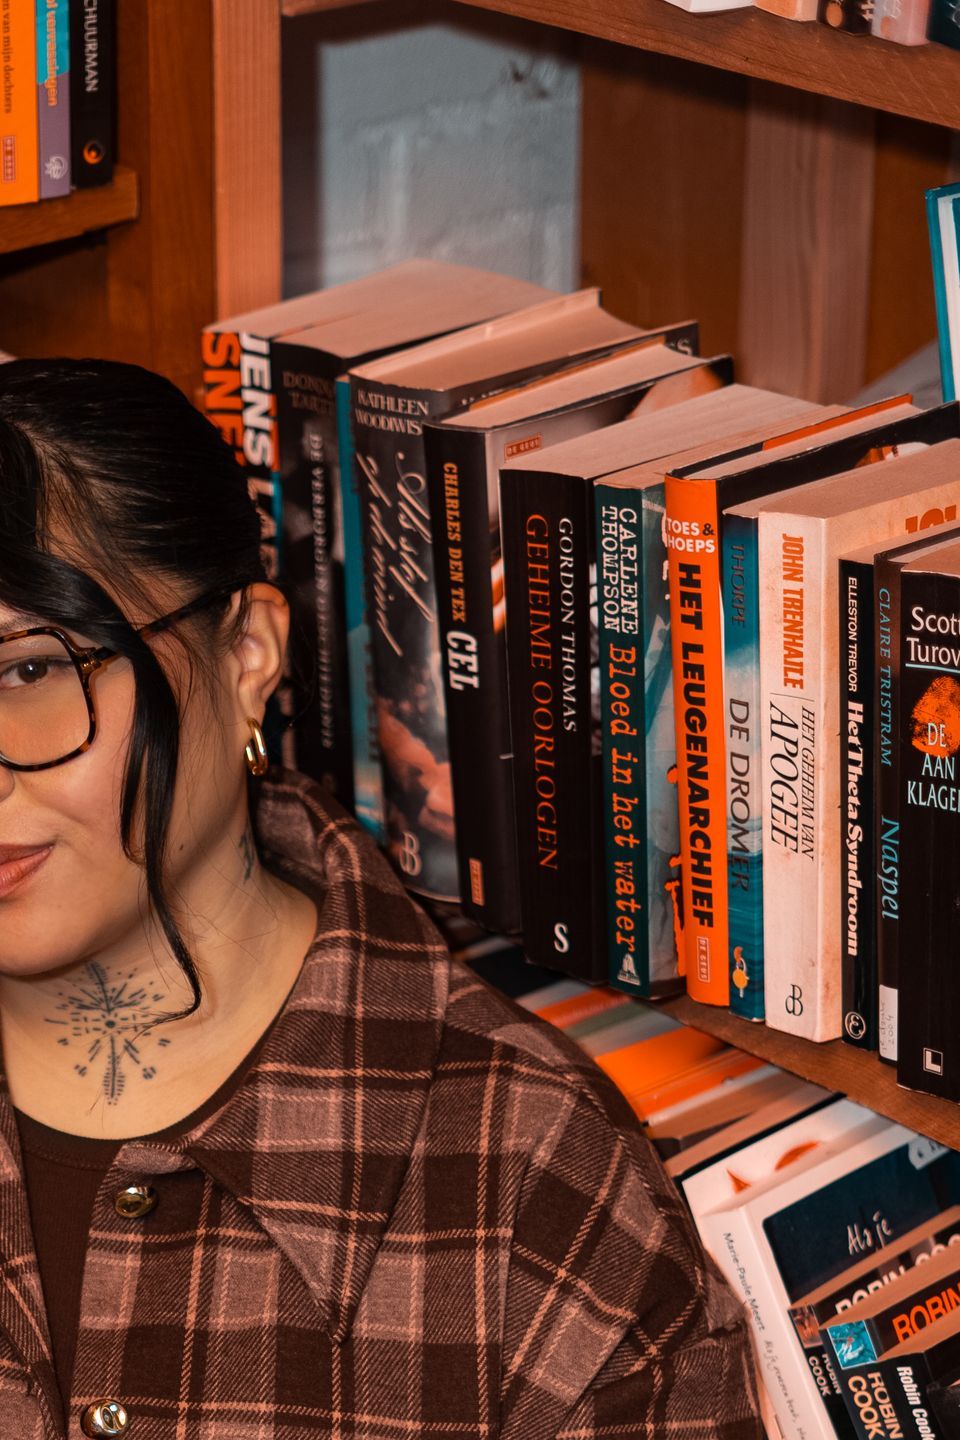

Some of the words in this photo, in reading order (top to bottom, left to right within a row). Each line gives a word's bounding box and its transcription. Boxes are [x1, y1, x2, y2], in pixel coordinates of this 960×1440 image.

[240, 332, 273, 468] JENS
[355, 409, 424, 436] WOODIWIS
[357, 389, 429, 417] KATHLEEN
[443, 462, 461, 541] CHARLES
[667, 518, 700, 537] TOES
[702, 522, 716, 536] &
[448, 547, 464, 585] DEN
[558, 517, 576, 624] GORDON
[601, 505, 620, 633] THOMPSON
[618, 507, 639, 635] CARLENE
[667, 536, 716, 554] HOEPS
[782, 533, 804, 583] JOHN
[451, 588, 466, 623] TEX
[526, 514, 552, 670] GEHEIME
[678, 562, 703, 631] HET
[848, 576, 858, 640] ELLESTON
[878, 588, 890, 659] CLAIRE
[446, 631, 480, 691] CEL
[783, 588, 804, 690] TRENHAILE
[848, 642, 858, 693] TREVOR
[560, 631, 577, 732] THOMAS
[608, 643, 638, 737] Bloed
[728, 698, 750, 743] DE
[801, 705, 815, 744] HET
[847, 700, 863, 742] Het
[880, 666, 892, 766] TRISTRAM
[927, 723, 947, 748] DE
[532, 680, 559, 870] OORLOGEN
[611, 747, 639, 785] in
[681, 641, 714, 929] LEUGENARCHIEF
[769, 700, 801, 854] APOGEE
[801, 745, 815, 820] GEHEIM
[847, 742, 863, 820] Theta
[907, 781, 960, 813] KLAGE
[921, 753, 955, 779] AAN
[612, 792, 640, 848] het
[728, 751, 751, 892] DROMER
[801, 822, 814, 861] VAN
[847, 823, 863, 957] Syndroom
[876, 815, 900, 920] Naspel
[614, 859, 642, 953] water
[847, 1225, 872, 1255] Als
[873, 1211, 893, 1250] je
[723, 1232, 751, 1299] Marie-Paule
[749, 1298, 767, 1332] Meert
[808, 1355, 831, 1397] COOK
[848, 1375, 885, 1440] COOK
[868, 1371, 904, 1439] ROBIN
[897, 1366, 921, 1405] Robin
